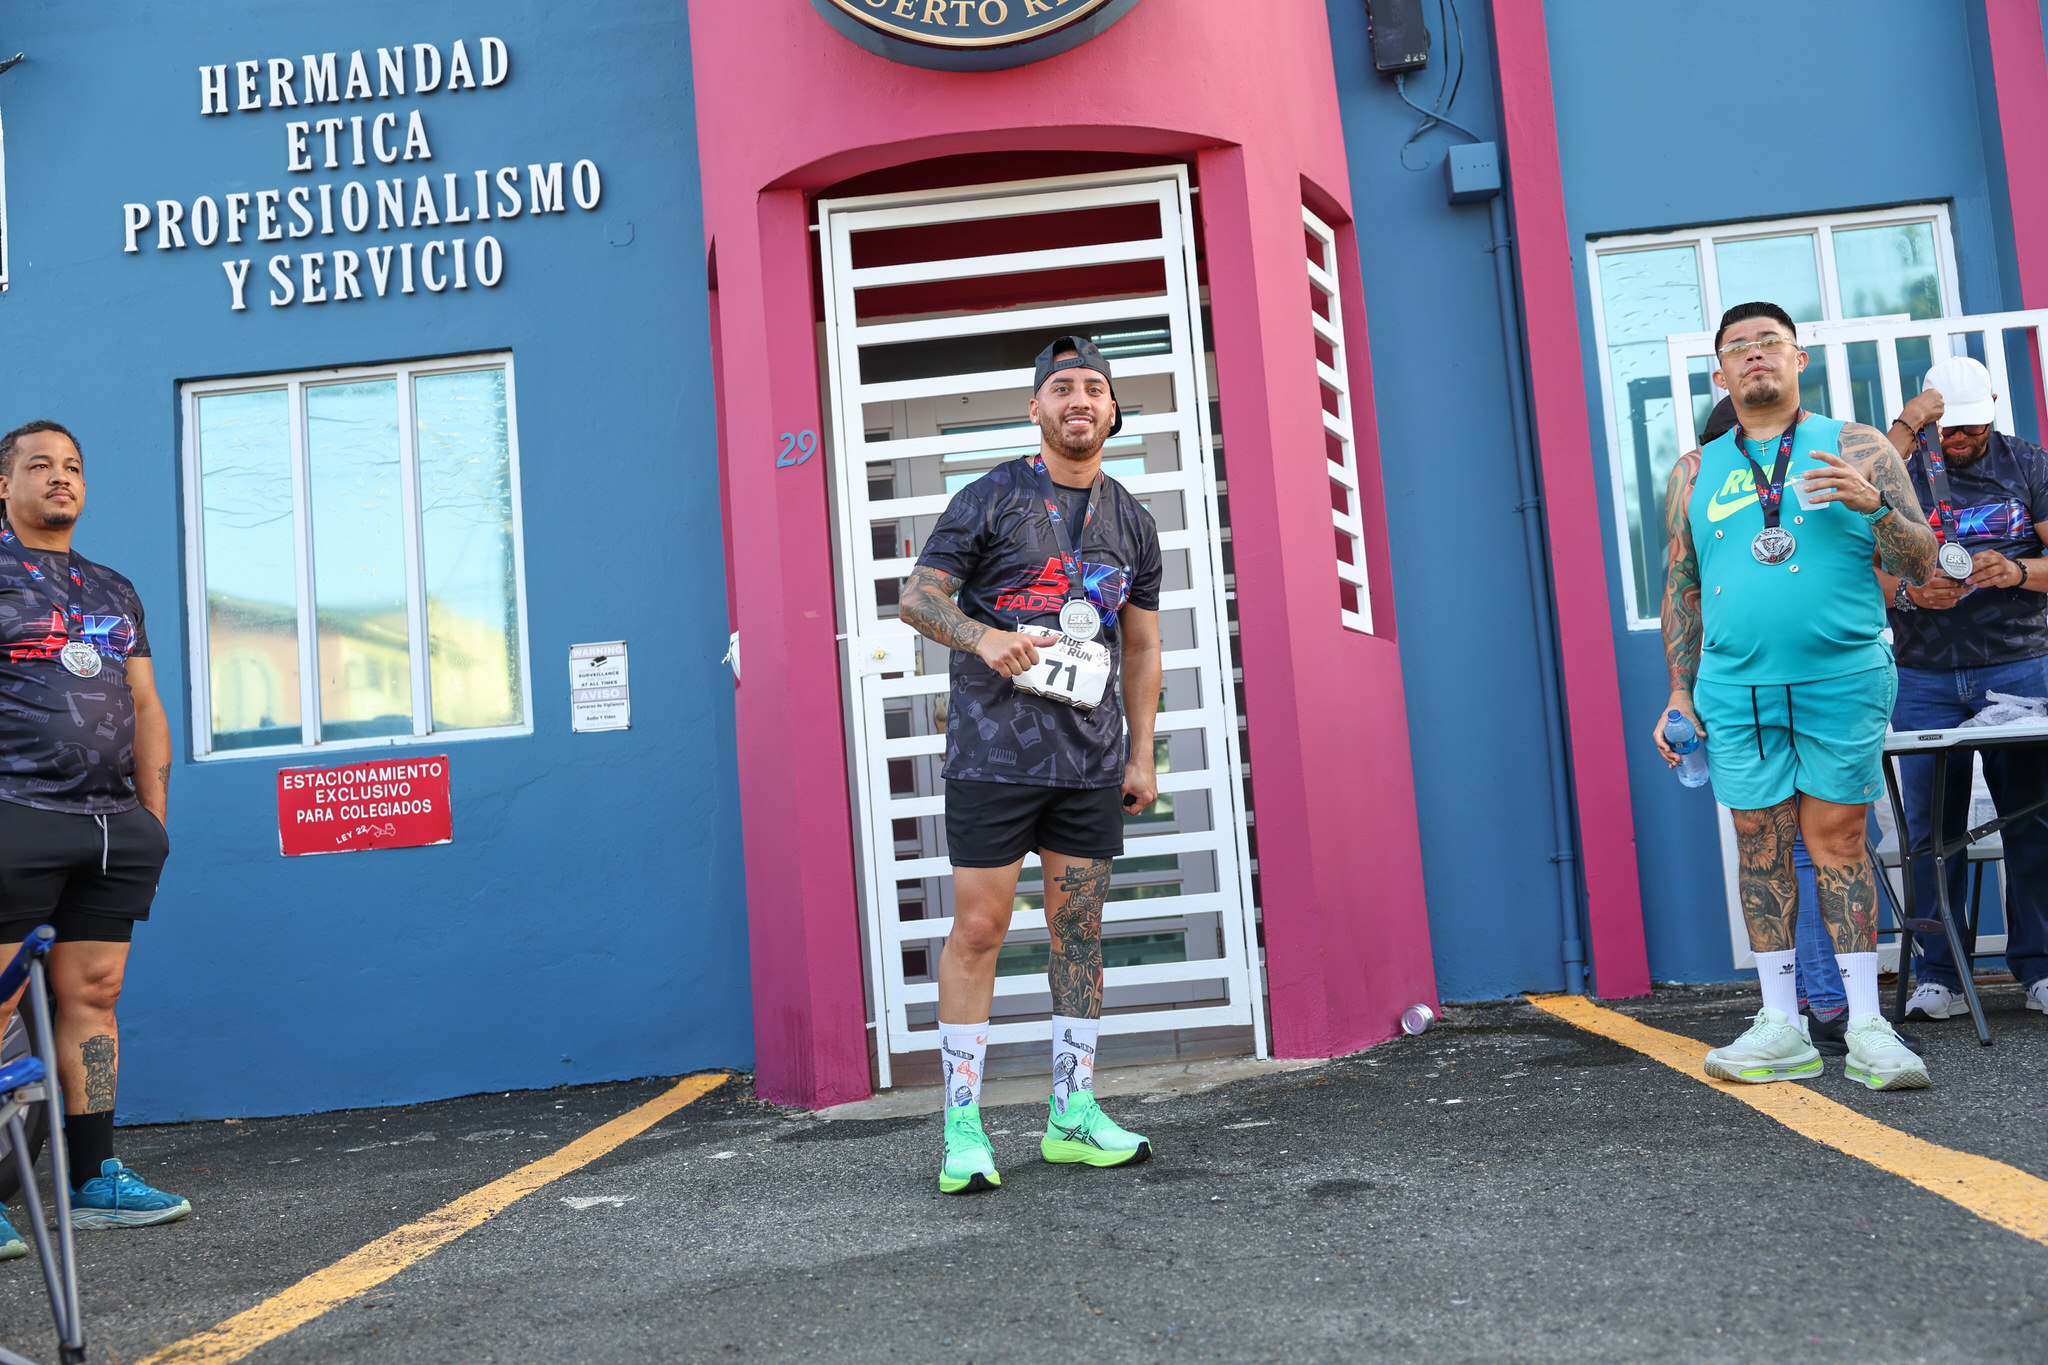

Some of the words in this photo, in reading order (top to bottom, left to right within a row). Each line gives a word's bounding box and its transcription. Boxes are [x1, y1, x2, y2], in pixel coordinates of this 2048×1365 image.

[198, 36, 509, 115] HERMANDAD
[286, 109, 432, 172] ETICA
[123, 158, 601, 252] PROFESIONALISMO
[222, 259, 250, 310] Y
[269, 235, 502, 306] SERVICIO
[776, 430, 817, 468] 29
[994, 594, 1064, 612] FADE
[573, 645, 623, 658] WARNING
[1067, 647, 1093, 662] RUN
[578, 670, 620, 678] SURVEILLANCE
[1045, 658, 1078, 692] 71
[580, 688, 620, 700] AVISO
[283, 763, 442, 790] ESTACIONAMIENTO
[315, 782, 411, 804] EXCLUSIVO
[296, 808, 335, 824] PARA
[340, 799, 432, 820] COLEGIADOS
[335, 831, 353, 844] LEY
[355, 825, 367, 836] 22
